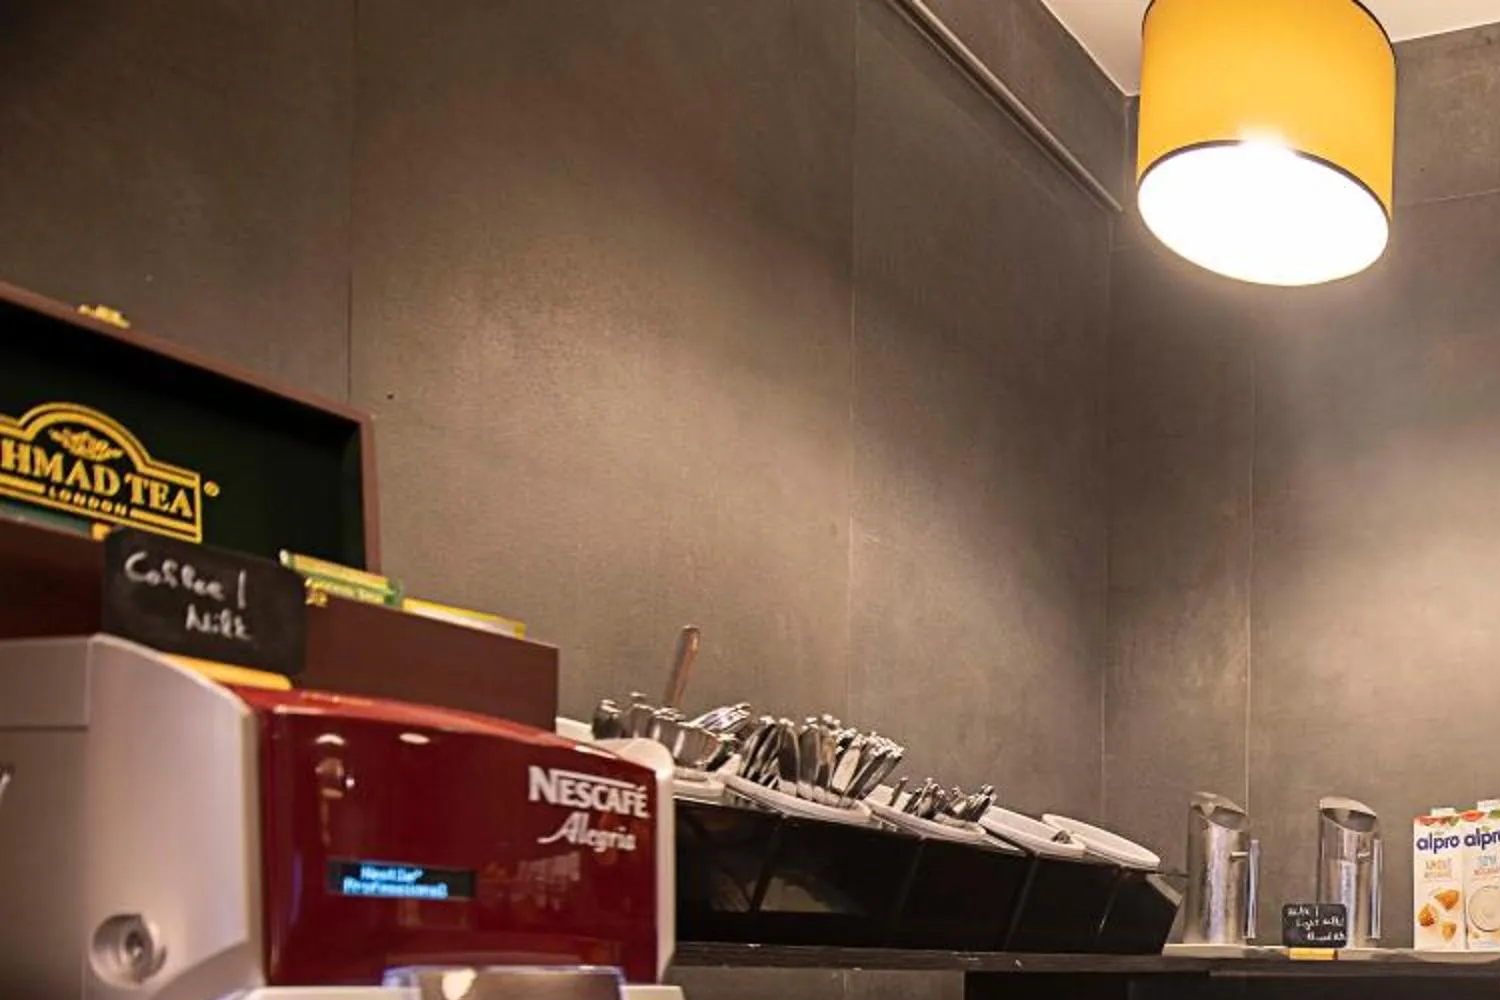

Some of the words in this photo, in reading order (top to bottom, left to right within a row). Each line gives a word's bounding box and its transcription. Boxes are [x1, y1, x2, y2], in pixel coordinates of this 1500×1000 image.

[0, 437, 121, 497] HMAD
[124, 472, 194, 518] TEA
[48, 486, 128, 517] LONDON
[528, 765, 651, 819] NESCAFÉ
[536, 811, 636, 853] Alegria
[1416, 832, 1460, 855] alpro
